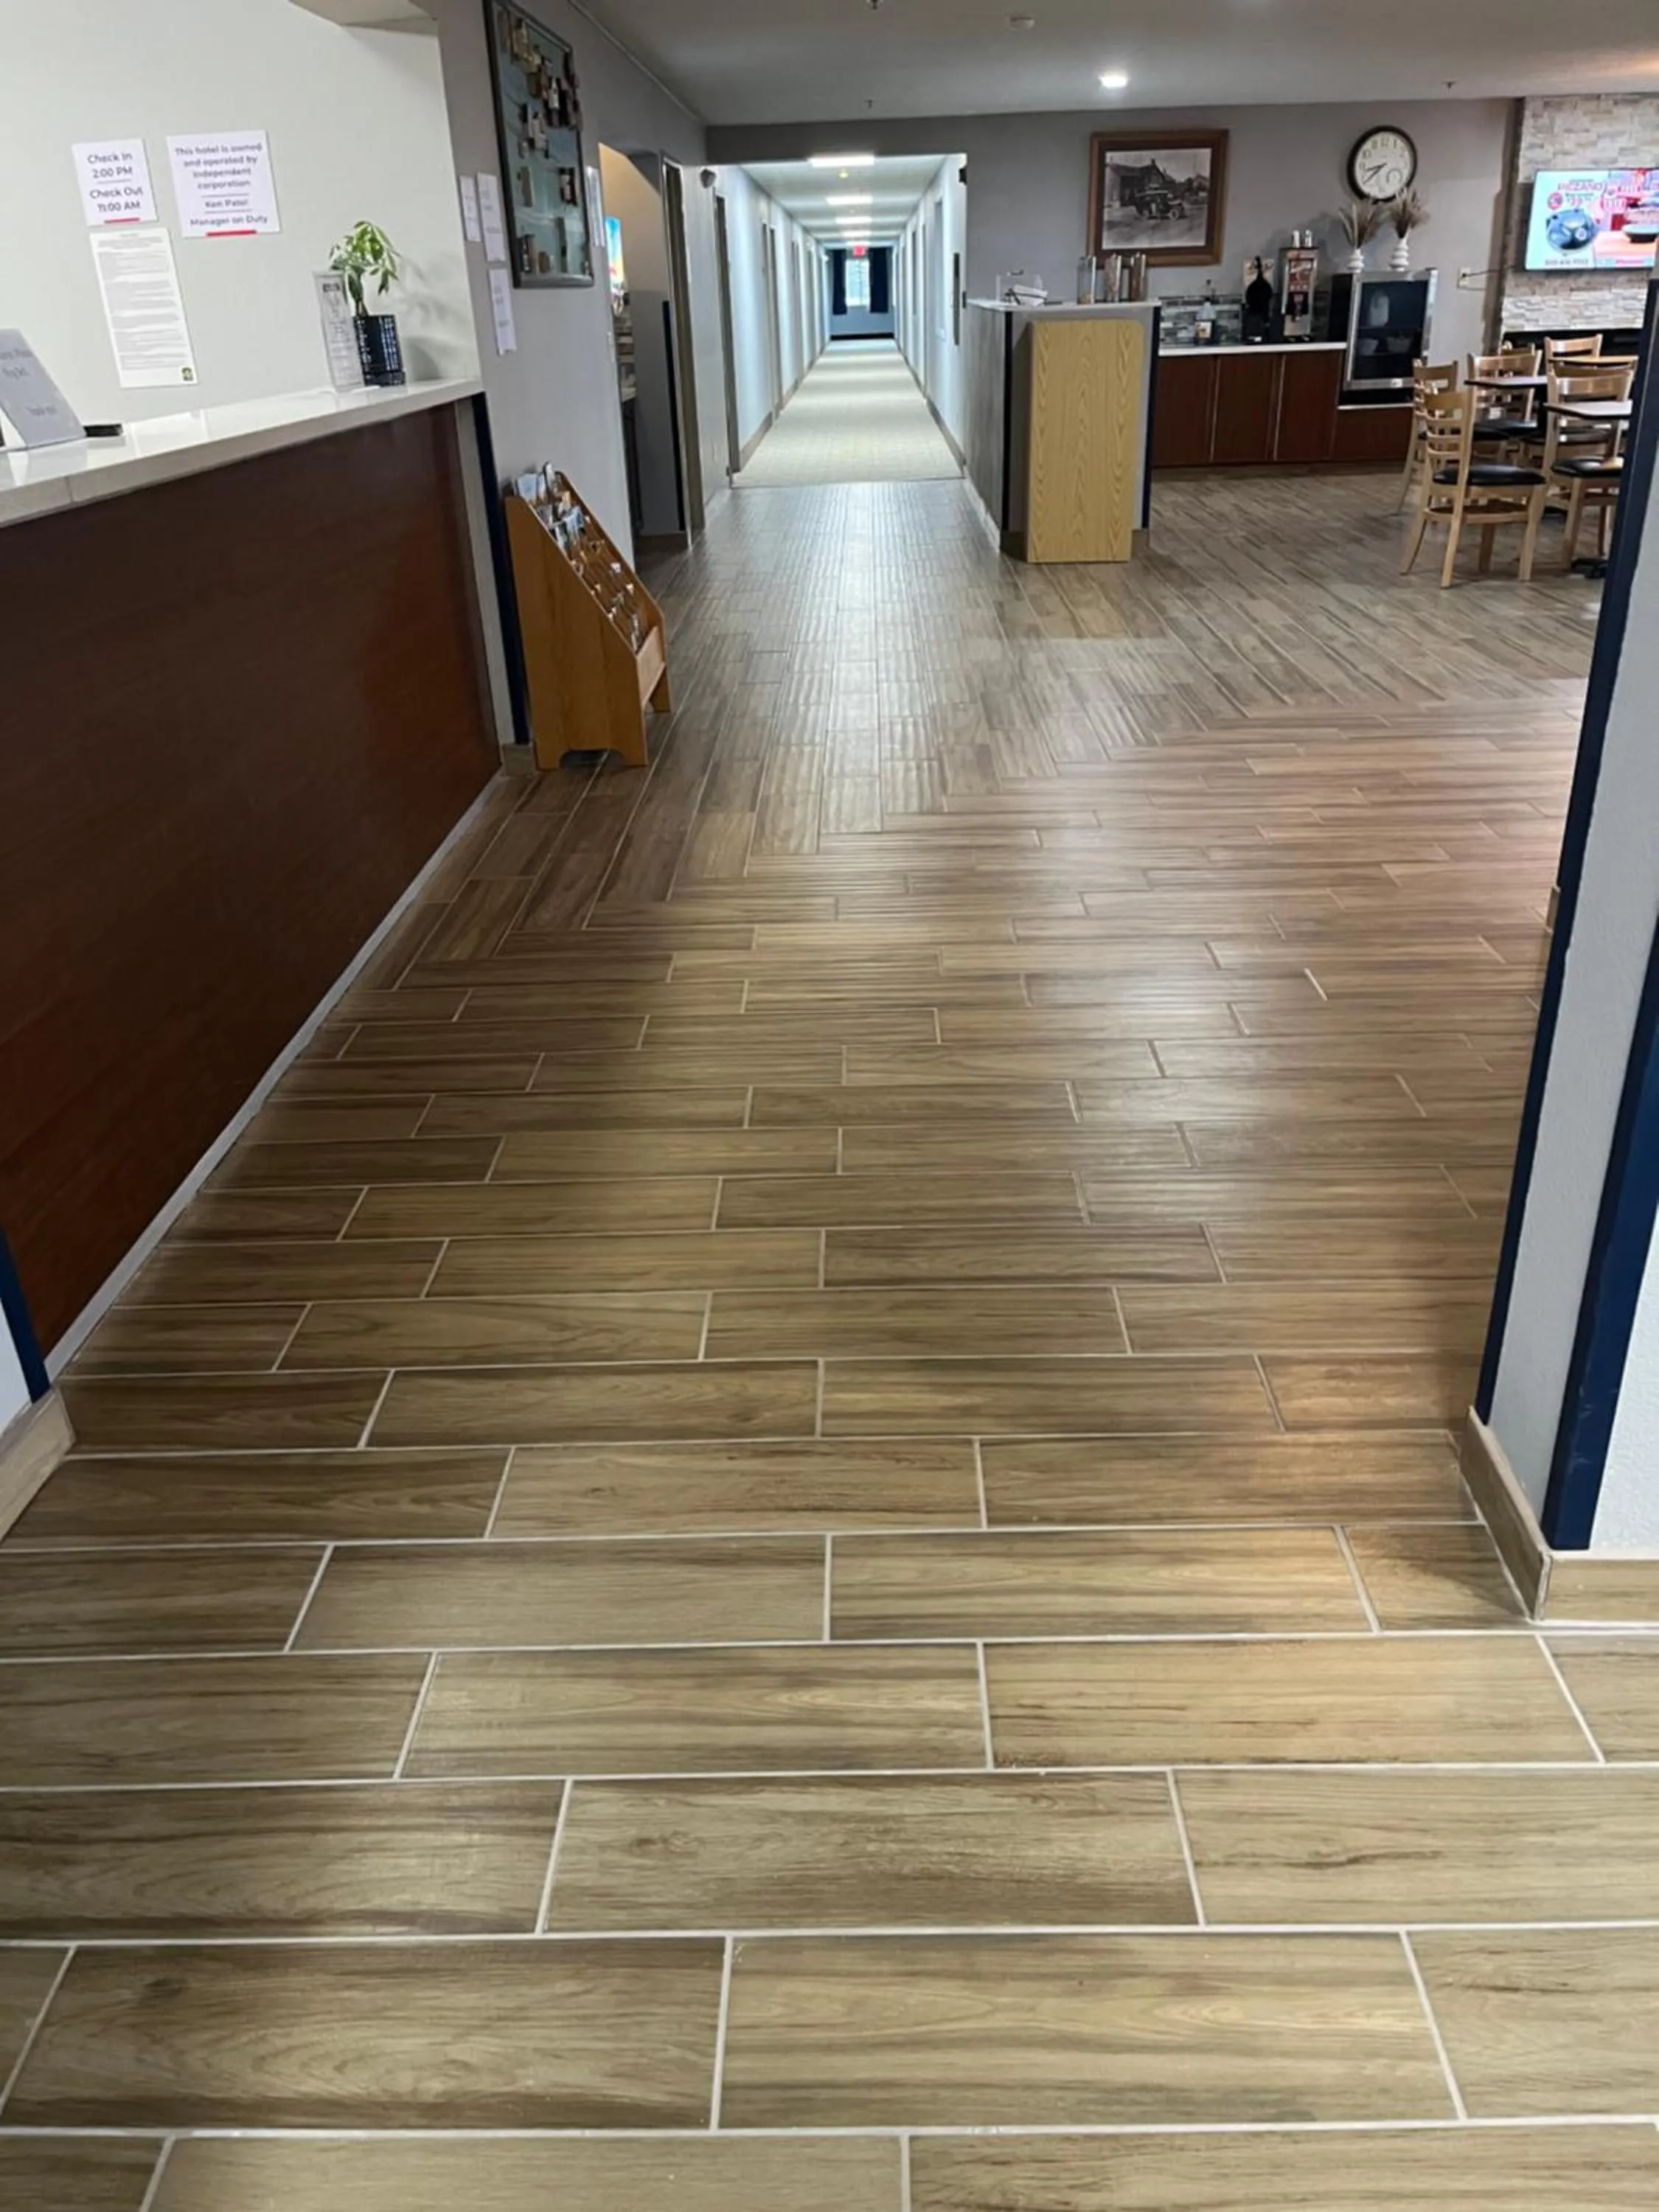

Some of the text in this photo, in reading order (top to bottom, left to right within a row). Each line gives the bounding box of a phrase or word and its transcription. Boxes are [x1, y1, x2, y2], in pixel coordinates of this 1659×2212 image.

[175, 142, 262, 156] This hotel is owned
[87, 153, 119, 164] Check
[184, 156, 258, 167] and operated by
[116, 166, 133, 175] PM
[89, 187, 144, 199] Check Out
[97, 201, 141, 212] 11:00 AM
[189, 215, 268, 227] Manager on Duty
